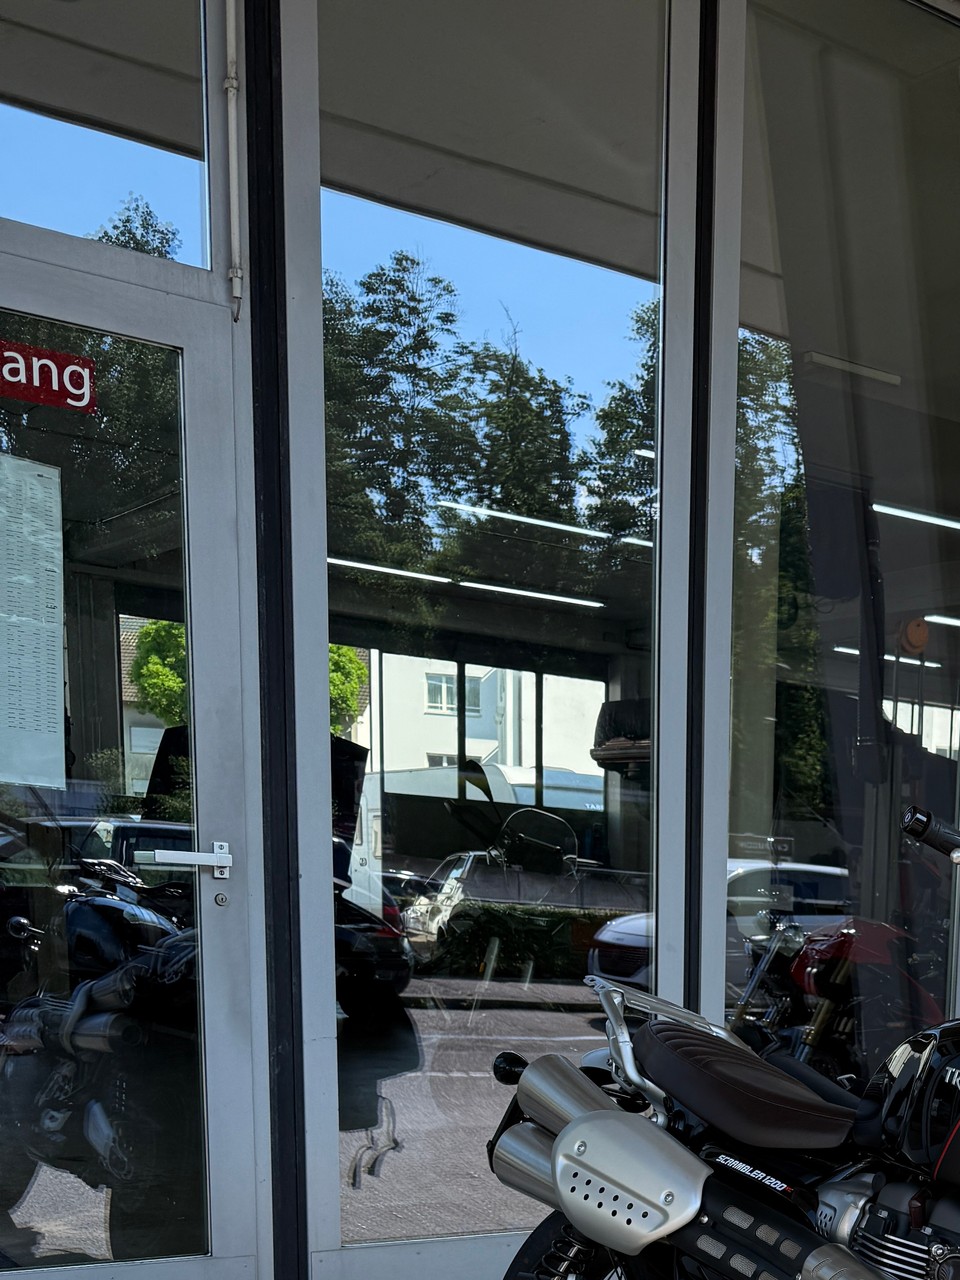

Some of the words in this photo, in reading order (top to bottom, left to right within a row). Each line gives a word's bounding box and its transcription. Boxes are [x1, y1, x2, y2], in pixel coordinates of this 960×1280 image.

[2, 351, 91, 407] ang
[716, 1154, 766, 1181] SCRAMBLER
[762, 1176, 787, 1191] 1200
